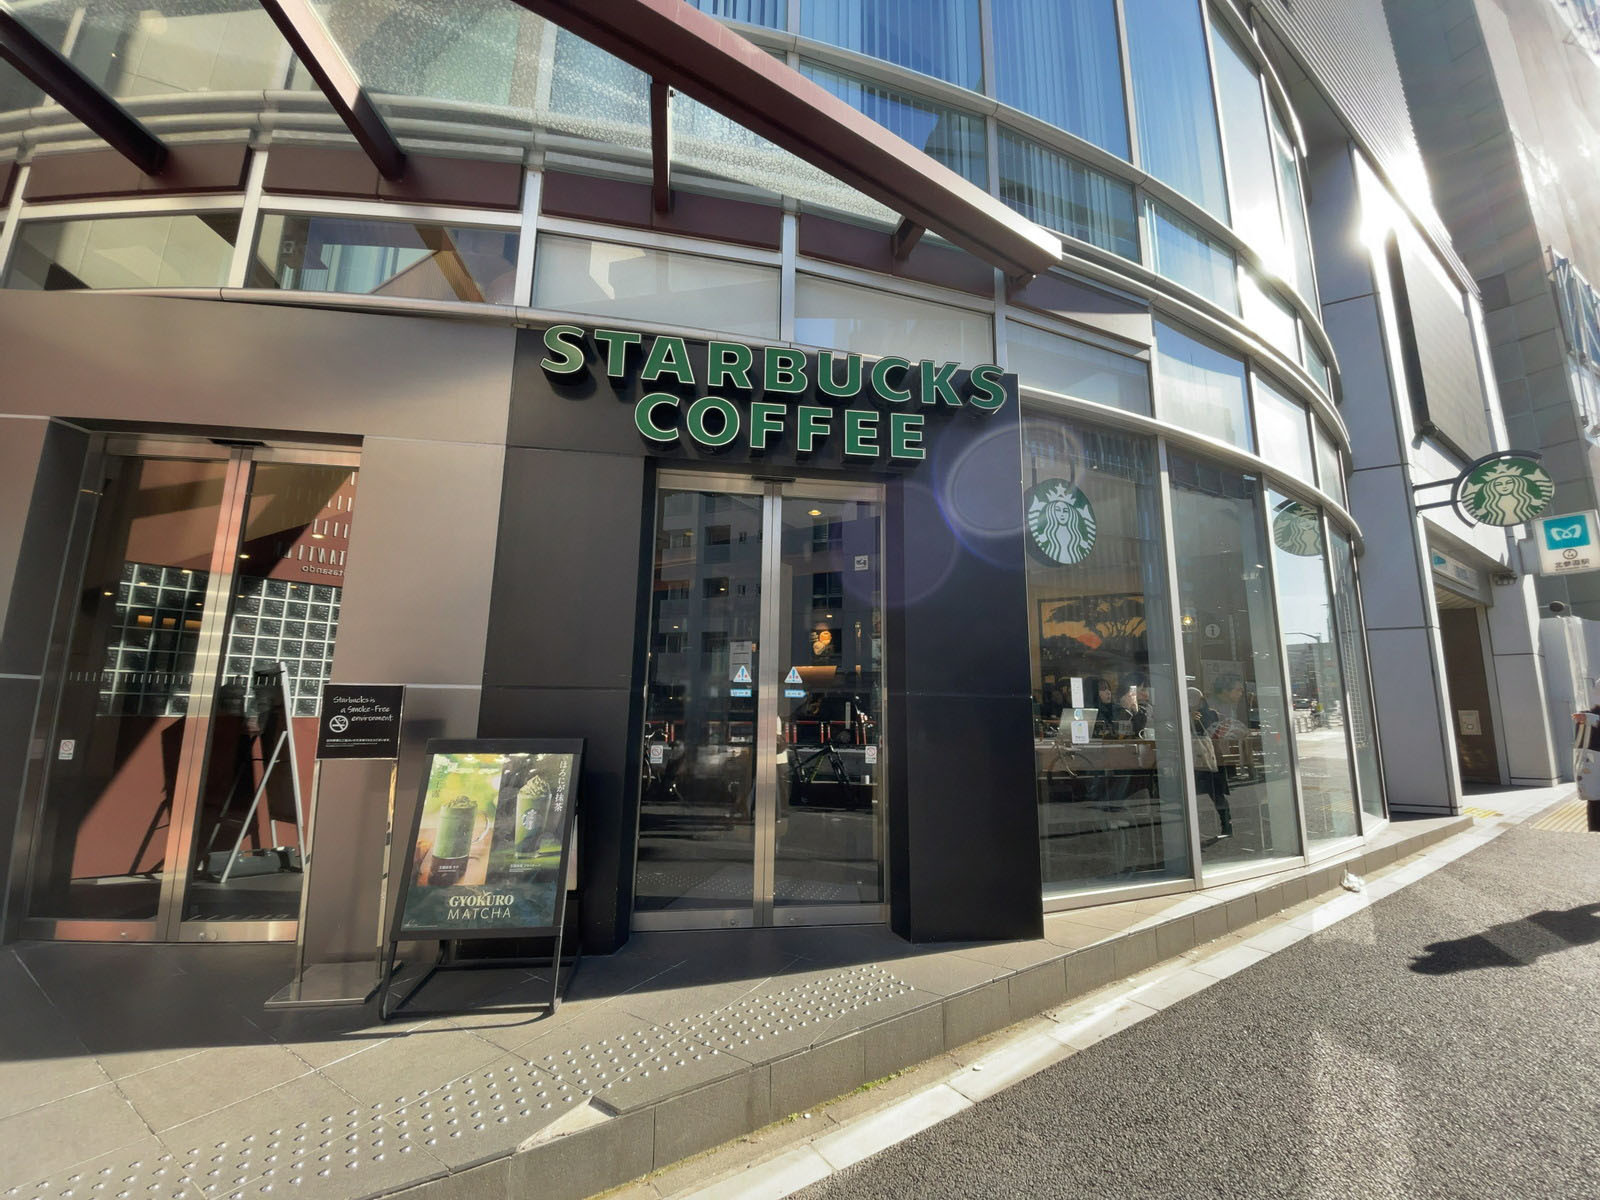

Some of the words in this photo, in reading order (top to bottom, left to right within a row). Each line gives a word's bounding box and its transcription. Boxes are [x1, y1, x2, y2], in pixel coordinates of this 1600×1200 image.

[540, 324, 1008, 413] STARBUCKS
[633, 392, 927, 460] COFFEE
[333, 695, 369, 704] Starbucks
[347, 704, 391, 713] Smoke-Free
[351, 714, 394, 722] environment
[448, 890, 515, 907] GYOKURO
[447, 907, 511, 920] MATCHA
